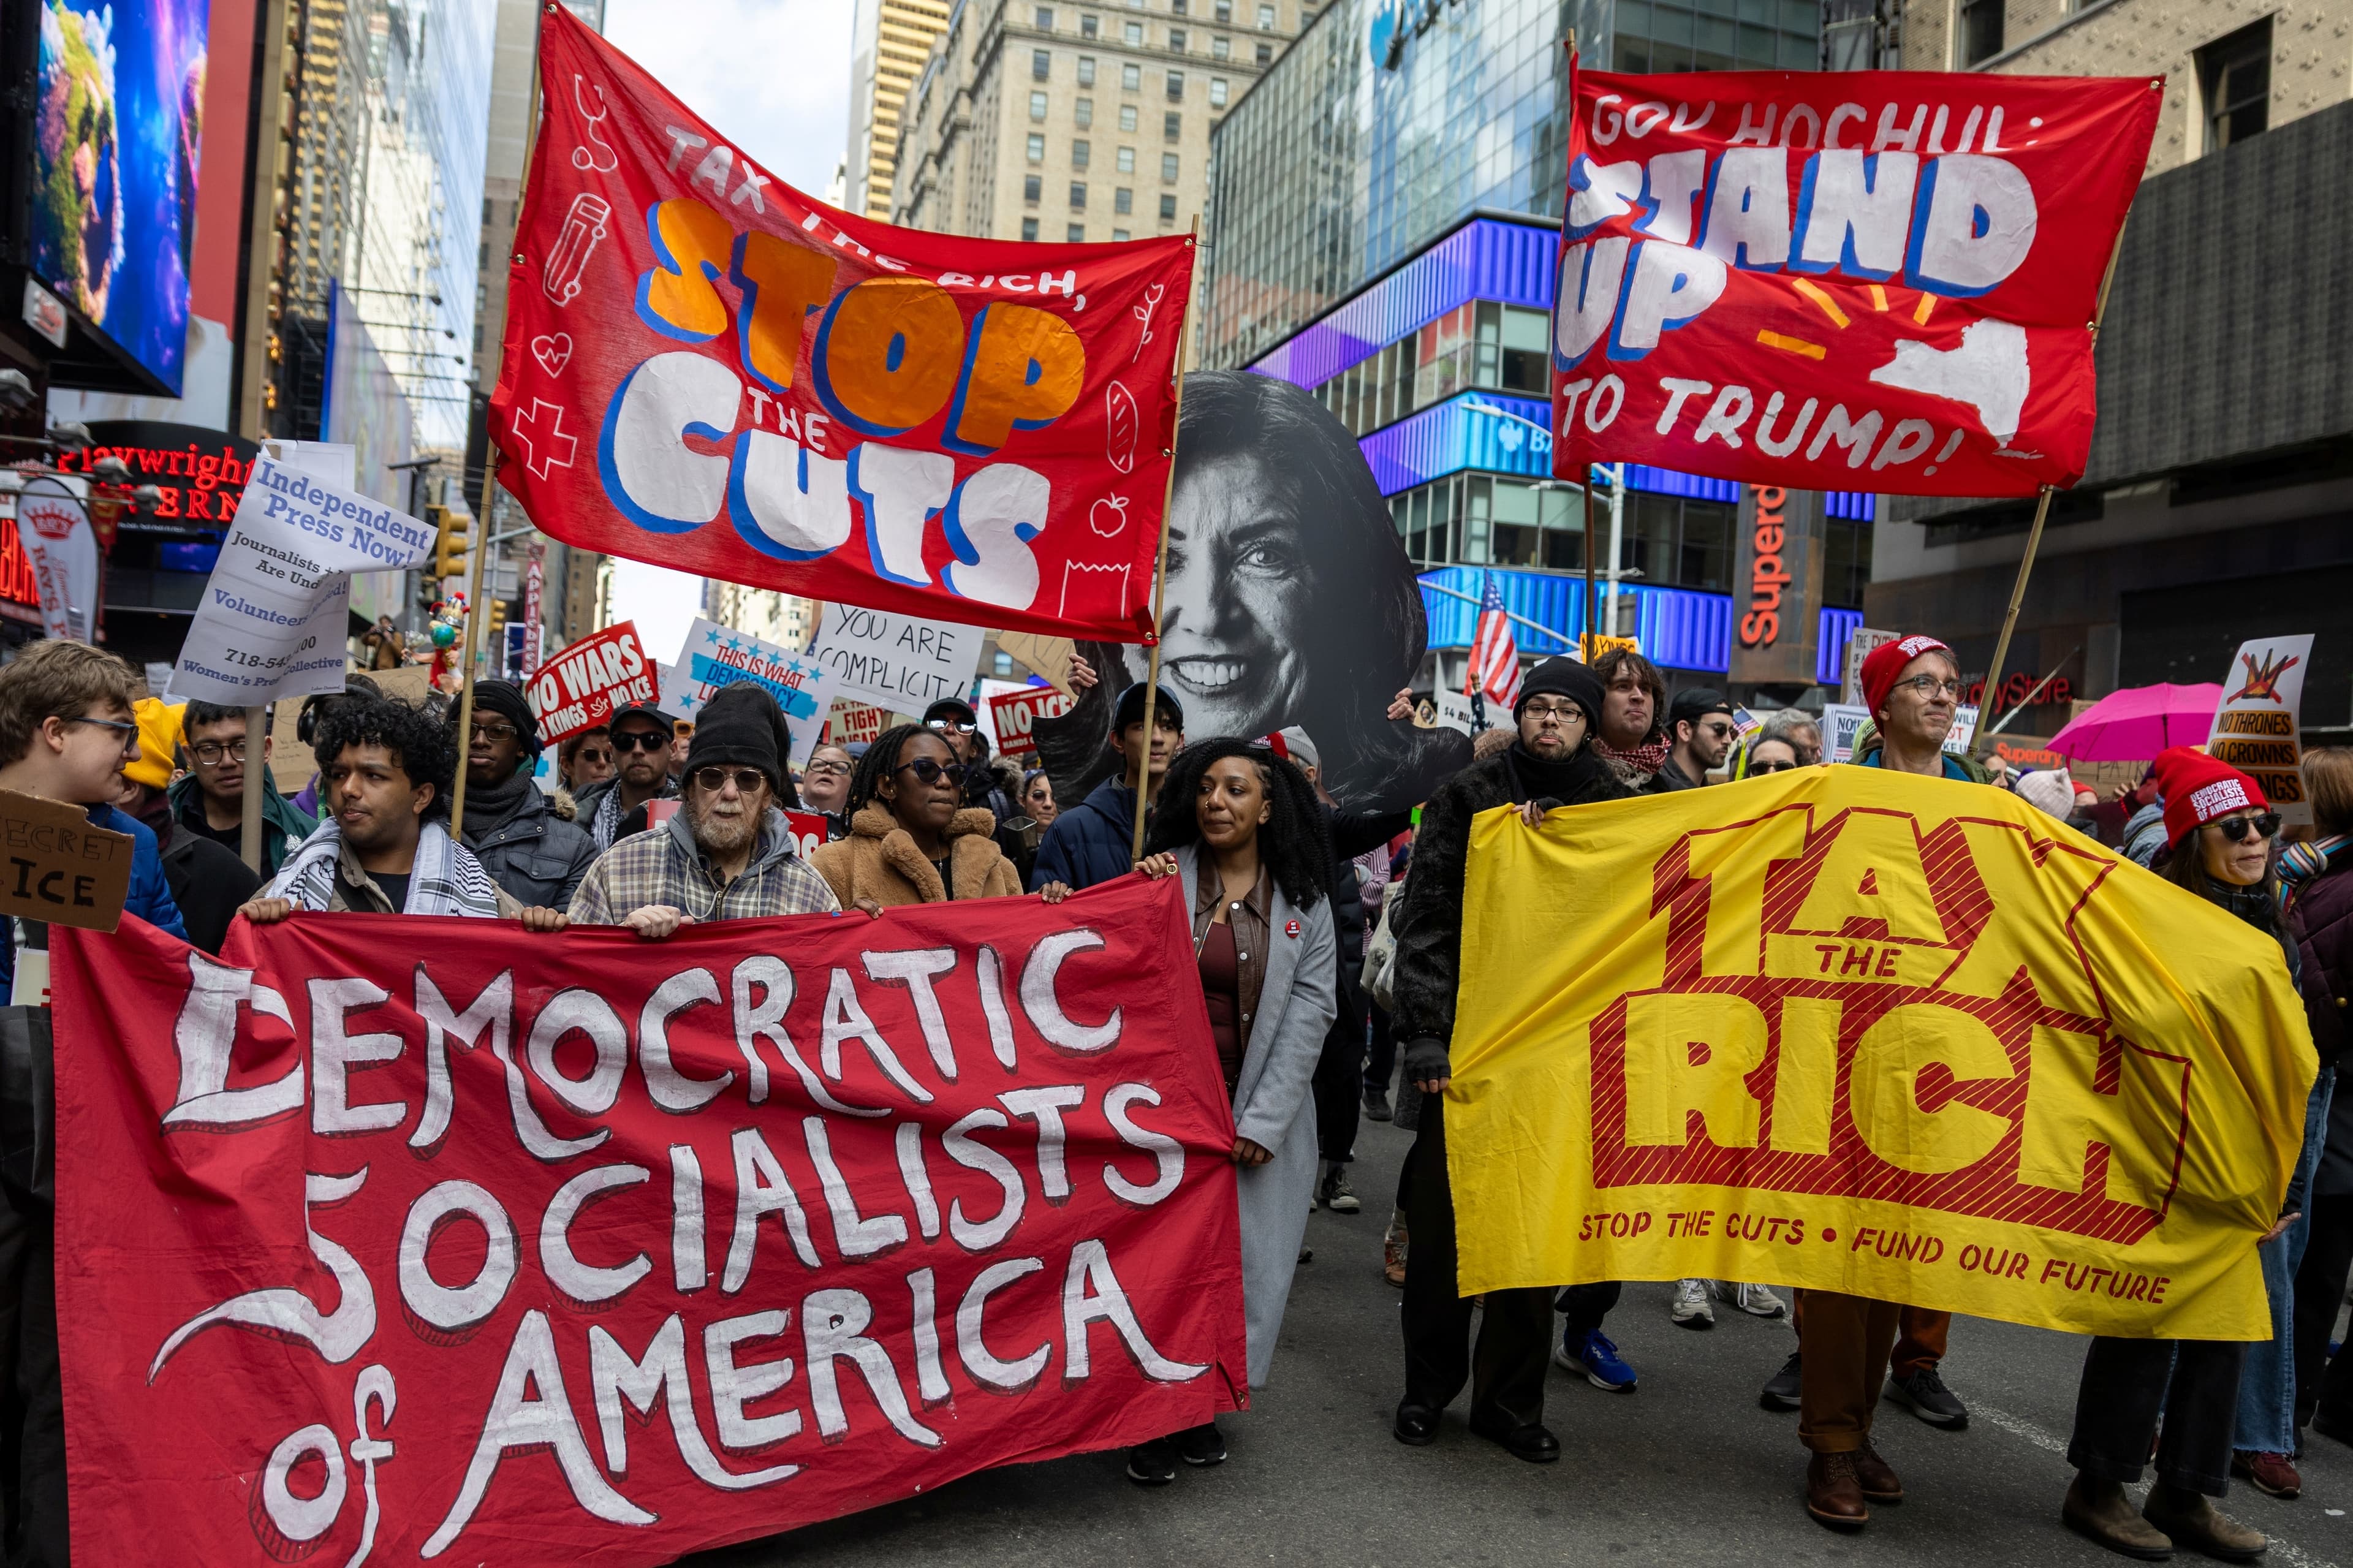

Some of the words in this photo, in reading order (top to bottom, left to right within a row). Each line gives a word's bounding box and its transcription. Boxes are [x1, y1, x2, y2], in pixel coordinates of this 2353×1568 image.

[666, 124, 770, 214] TAX
[937, 270, 1085, 311] RICH,
[1564, 146, 2038, 297] STAND
[635, 197, 1085, 456] STOP
[1553, 237, 1727, 371] UP
[747, 385, 830, 452] THE
[1563, 374, 1624, 438] TO
[1656, 376, 1964, 476] TRUMP!
[256, 461, 428, 550] Independent
[598, 352, 1050, 610] CUTS
[232, 531, 320, 575] Journalists
[263, 493, 344, 543] Press
[349, 526, 414, 569] Now!
[256, 559, 286, 578] Are
[1740, 483, 1791, 645] Superd
[835, 603, 887, 640] YOU
[896, 624, 955, 663] ARE
[183, 659, 251, 686] Women's
[284, 657, 344, 676] Collective
[528, 673, 559, 720] NO
[558, 634, 643, 702] WARS
[716, 645, 748, 670] THIS
[747, 656, 764, 675] IS
[764, 662, 806, 691] WHAT
[536, 720, 548, 741] O
[545, 702, 588, 738] KINGS
[608, 684, 632, 709] NO
[629, 675, 654, 700] ICE
[830, 702, 847, 712] TAX
[850, 700, 870, 709] TH
[844, 706, 884, 732] FIGHT
[995, 700, 1032, 738] NO
[1950, 727, 1965, 740] OT
[2218, 712, 2235, 733] NO
[2235, 713, 2292, 737] THRONES
[1002, 738, 1029, 749] HANDS
[1996, 742, 2063, 768] Superdry
[2227, 742, 2296, 765] CROWNS
[2189, 778, 2241, 803] DEMOCRATIC
[2192, 786, 2246, 811] SOCIALISTS
[2196, 808, 2208, 821] OF
[2209, 795, 2251, 817] AMERICA
[2259, 773, 2301, 803] NGS
[0, 817, 126, 862] ECRET
[10, 857, 96, 907] ICE
[1651, 803, 2116, 1018] TAX
[1814, 944, 1903, 979] THE
[161, 928, 1123, 1163] DEMOCRATIC
[1590, 987, 2192, 1245] RICH
[145, 1081, 1186, 1387] SOCIALISTS
[1578, 1212, 1651, 1242] STOP
[1667, 1210, 1715, 1239] THE
[1726, 1213, 1805, 1246] CUTS
[1851, 1228, 1944, 1265] FUND
[1959, 1244, 2029, 1281] OUR
[2040, 1259, 2170, 1305] FUTURE
[260, 1363, 397, 1568] of
[420, 1238, 1211, 1559] AMERICA
